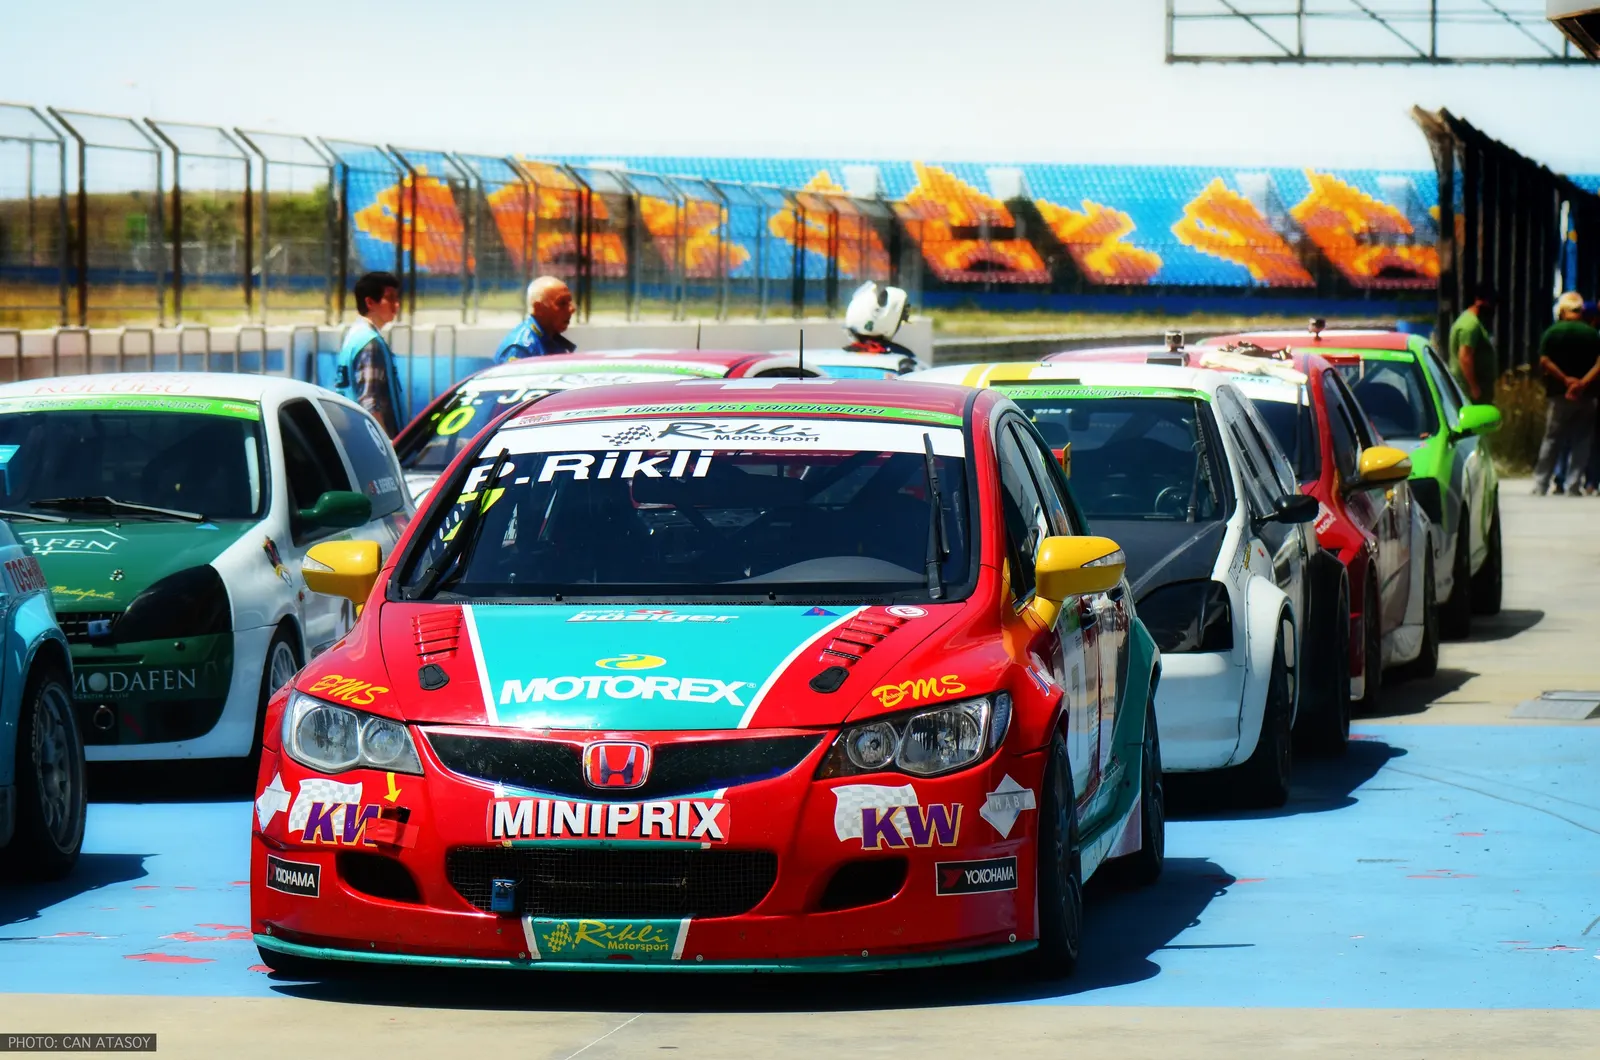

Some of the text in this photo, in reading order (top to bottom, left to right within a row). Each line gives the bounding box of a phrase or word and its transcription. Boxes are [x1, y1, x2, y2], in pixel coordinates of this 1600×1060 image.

[713, 434, 820, 443] Motorsport
[308, 674, 390, 706] DMS
[499, 674, 745, 707] MOTOREX
[871, 674, 967, 708] DMS
[493, 799, 727, 840] MINIPRIX
[861, 803, 964, 851] KW
[964, 865, 1015, 885] YOKOHAMA
[573, 919, 669, 949] Rikli
[606, 940, 670, 953] Motorsport
